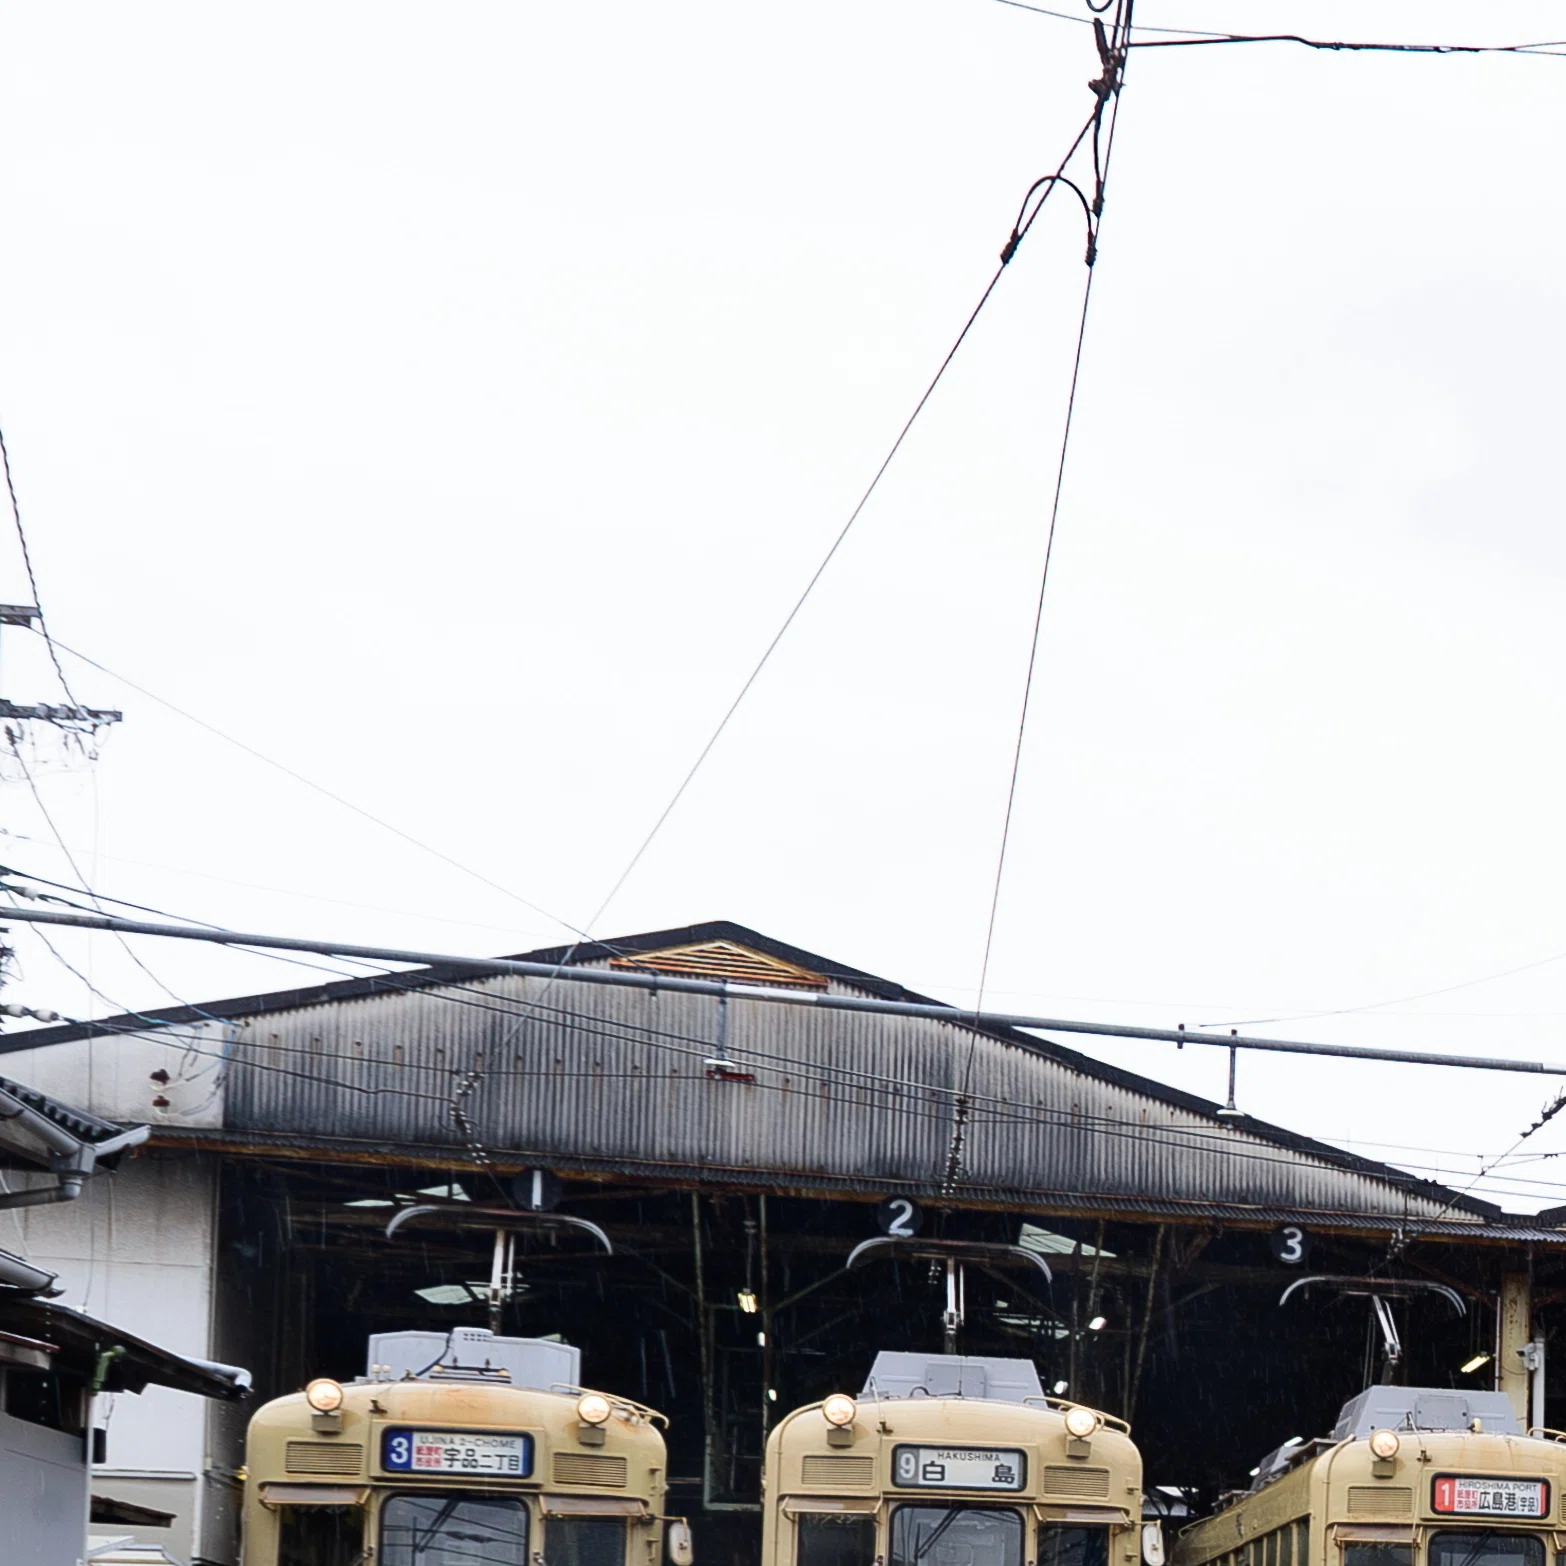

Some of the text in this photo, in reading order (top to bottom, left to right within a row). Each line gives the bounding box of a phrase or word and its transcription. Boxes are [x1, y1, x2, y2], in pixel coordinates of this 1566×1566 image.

[889, 1200, 914, 1237] 2
[1280, 1227, 1302, 1260] 3
[390, 1437, 409, 1463] 3
[420, 1436, 455, 1445] UJINA
[444, 1448, 520, 1471] 宇品二丁目
[900, 1453, 916, 1479] 9
[937, 1452, 1002, 1462] HAKUSHIMA
[922, 1460, 1015, 1484] 白島
[1441, 1483, 1450, 1507] 1
[1459, 1480, 1538, 1493] HIROSHIMA PORT
